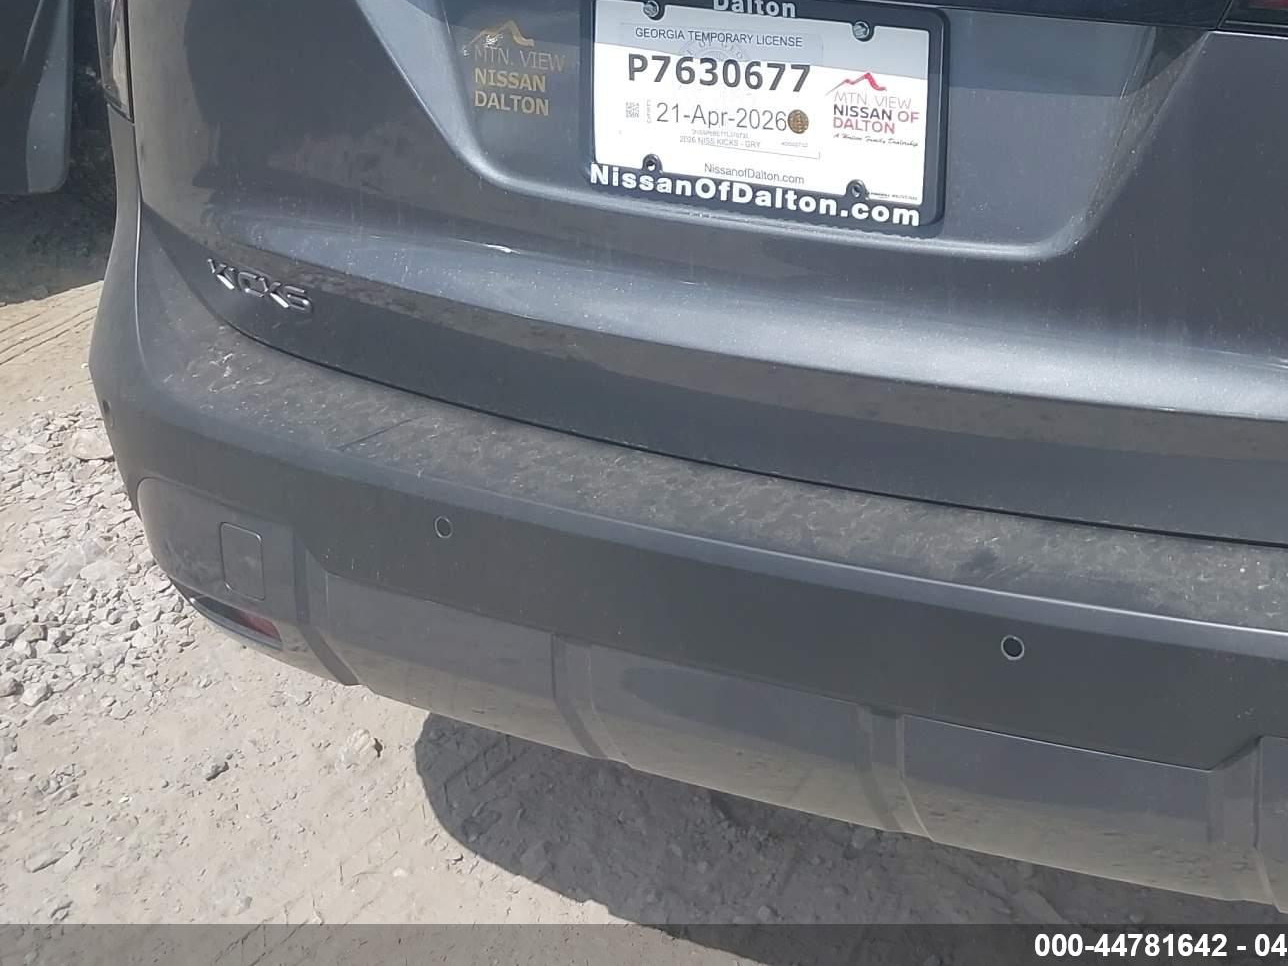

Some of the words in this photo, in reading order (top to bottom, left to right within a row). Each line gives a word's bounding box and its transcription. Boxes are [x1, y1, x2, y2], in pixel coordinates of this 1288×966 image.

[635, 27, 686, 40] GEORGIA
[688, 30, 754, 44] TEMPORARY
[756, 35, 803, 47] LICENSE
[519, 49, 567, 72] VIEW
[475, 67, 547, 93] NISSAN
[628, 53, 811, 93] P7630677
[474, 89, 549, 116] DALTON
[833, 104, 892, 122] NISSAN
[897, 110, 920, 123] OF
[874, 95, 912, 110] VIEW
[656, 102, 787, 132] 21-Apr-2026
[833, 117, 895, 135] DALTON
[704, 162, 805, 185] NissanofDalton.com
[590, 164, 920, 227] NissanOfDalton.com
